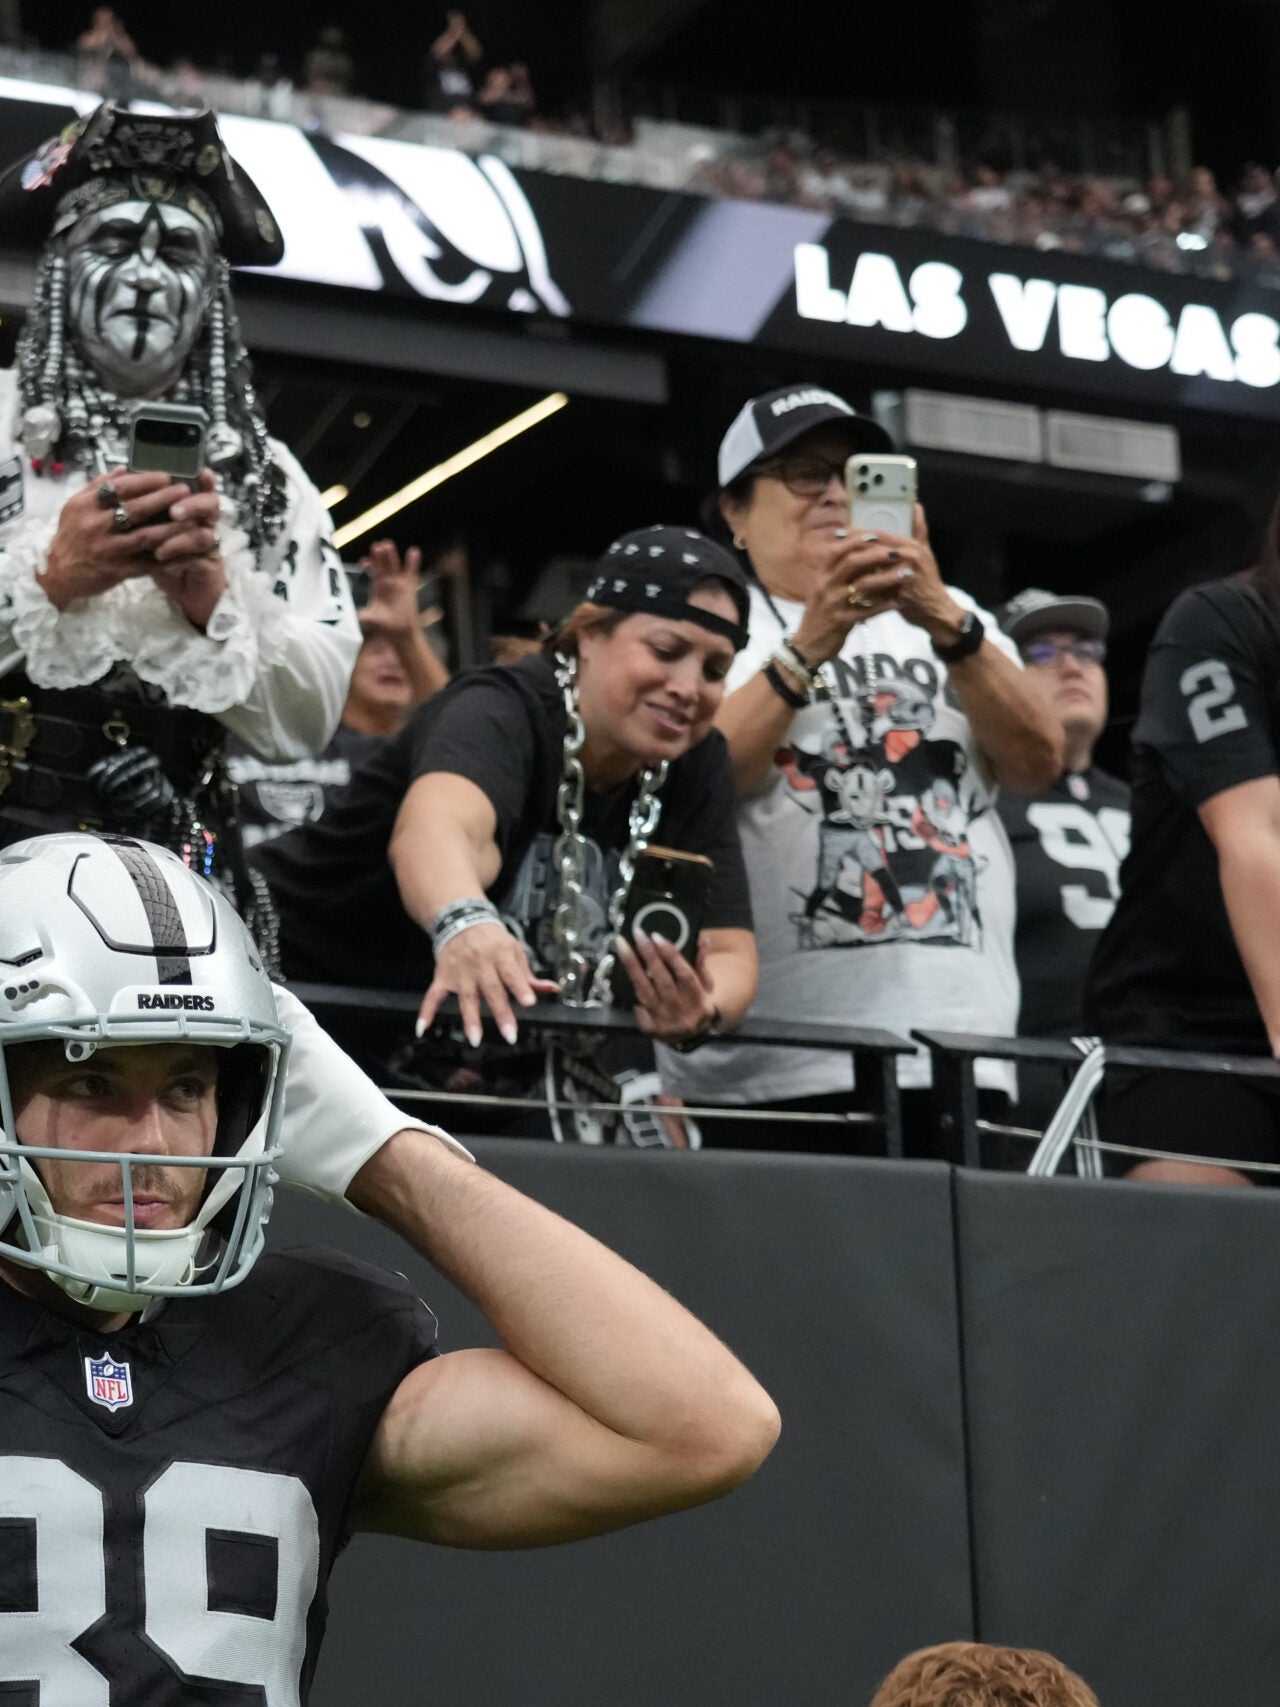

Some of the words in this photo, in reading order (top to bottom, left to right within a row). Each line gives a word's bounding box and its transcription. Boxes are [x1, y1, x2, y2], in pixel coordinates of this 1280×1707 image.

[793, 242, 968, 339] LAS
[987, 272, 1280, 388] VEGAS
[1180, 658, 1249, 745] 2
[136, 993, 216, 1012] RAIDERS
[95, 1378, 127, 1402] NFL
